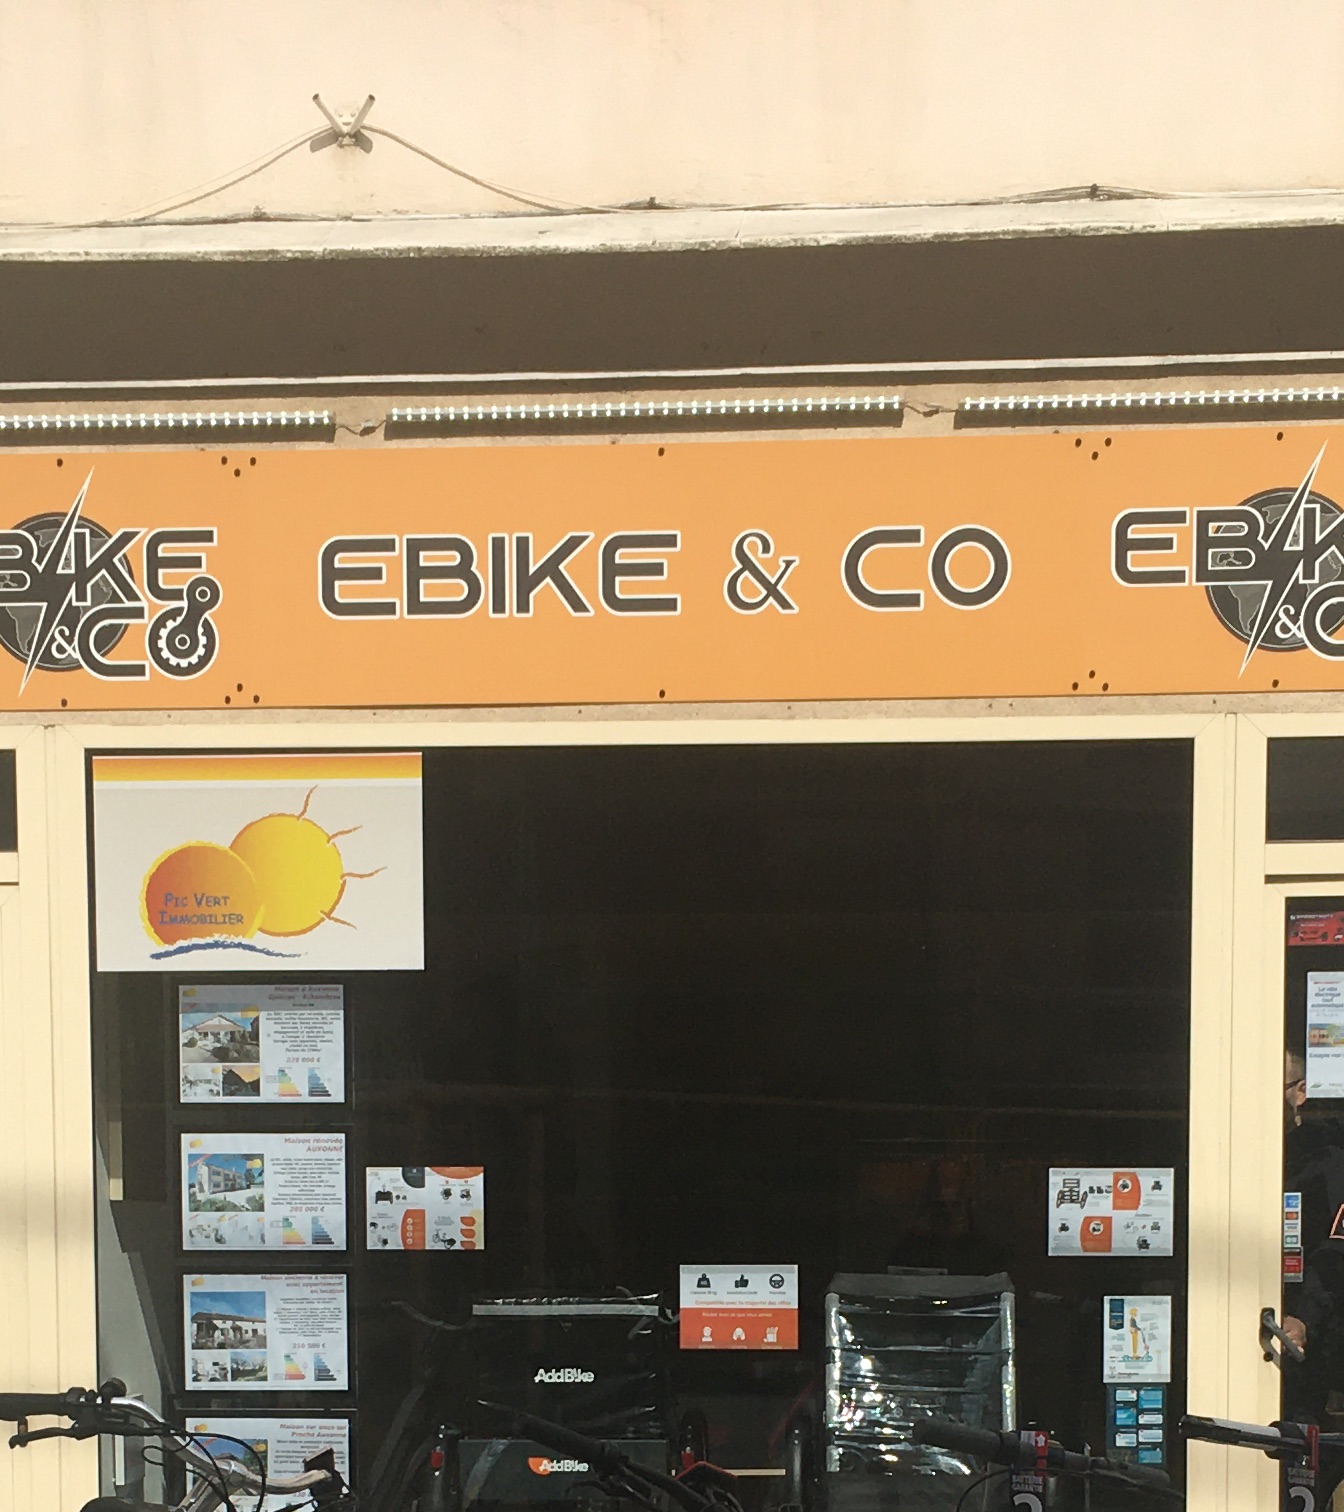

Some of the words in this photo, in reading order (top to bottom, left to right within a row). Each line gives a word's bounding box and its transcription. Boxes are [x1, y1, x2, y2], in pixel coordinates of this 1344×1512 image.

[317, 529, 682, 620] EBIKE
[722, 531, 800, 615] &
[840, 524, 1012, 612] CO
[193, 892, 231, 908] VERT
